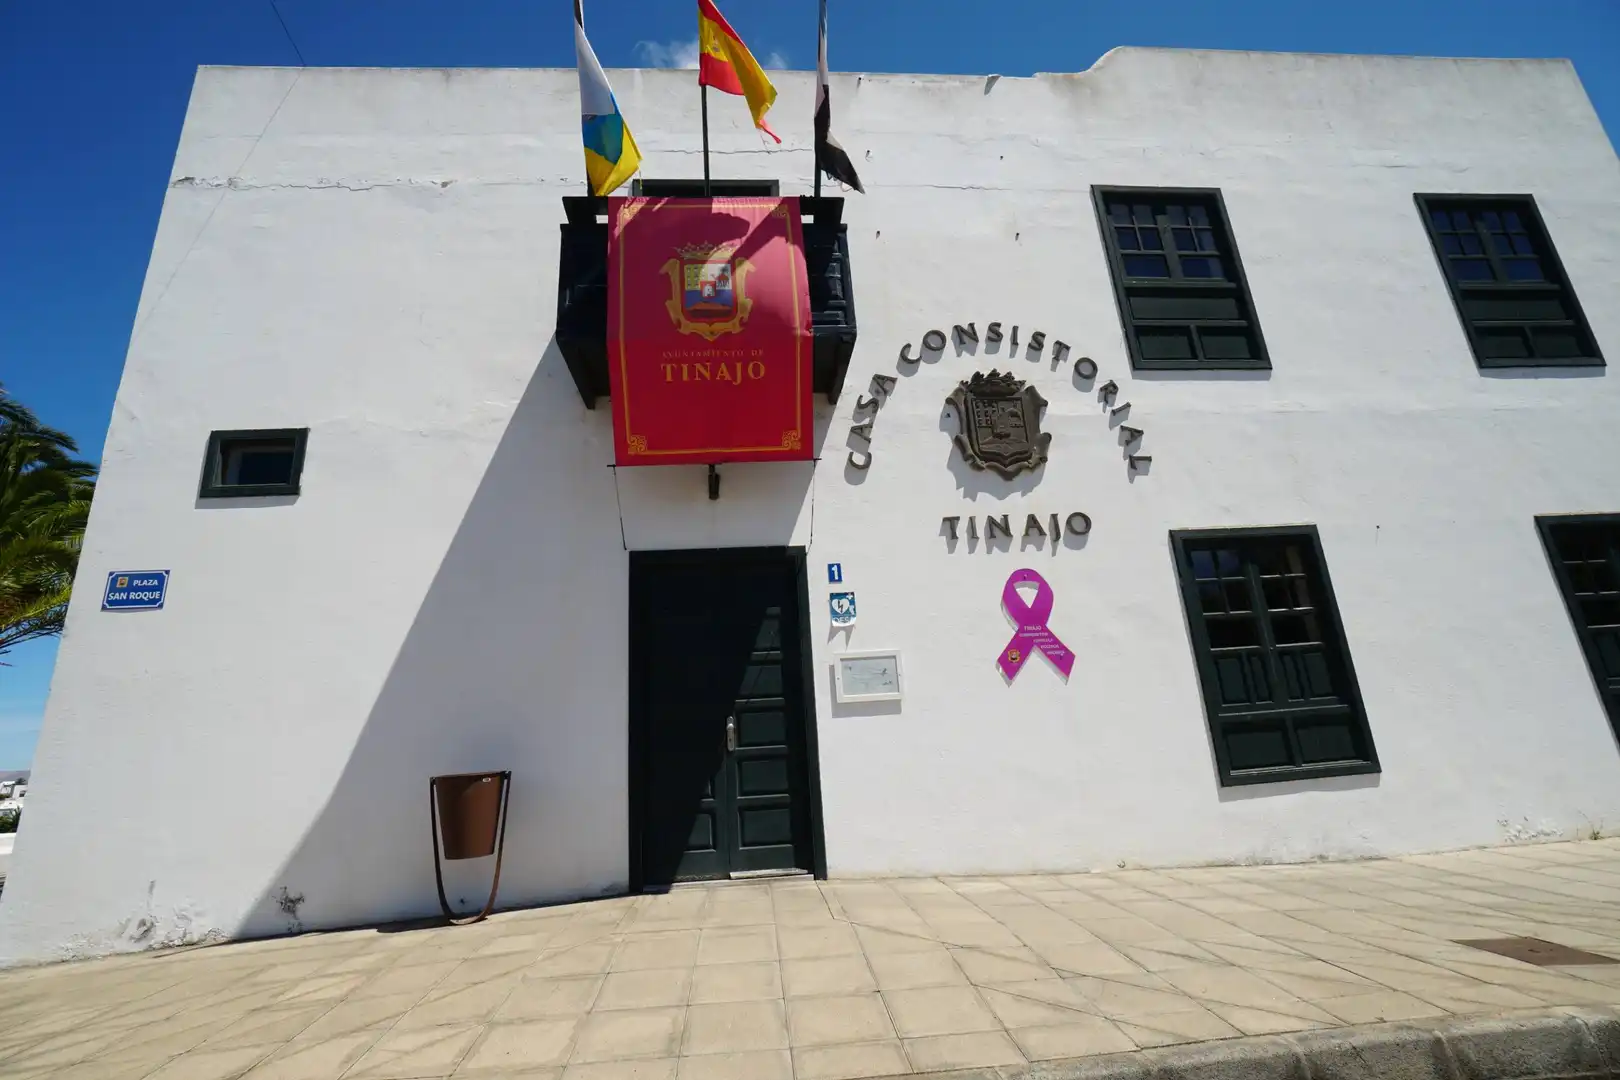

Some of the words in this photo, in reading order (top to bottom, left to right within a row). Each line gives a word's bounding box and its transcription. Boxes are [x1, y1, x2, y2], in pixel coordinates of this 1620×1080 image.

[662, 348, 744, 358] AYUNTAMIENTO
[751, 348, 764, 357] DE
[660, 360, 765, 385] TINAJO
[848, 373, 898, 470] CASA
[900, 322, 1152, 470] CONSISTORIAL
[942, 512, 1092, 542] TINAJO
[831, 564, 839, 580] 1
[133, 579, 159, 587] PLAZA
[108, 592, 128, 601] SAN
[129, 591, 161, 601] ROQUE
